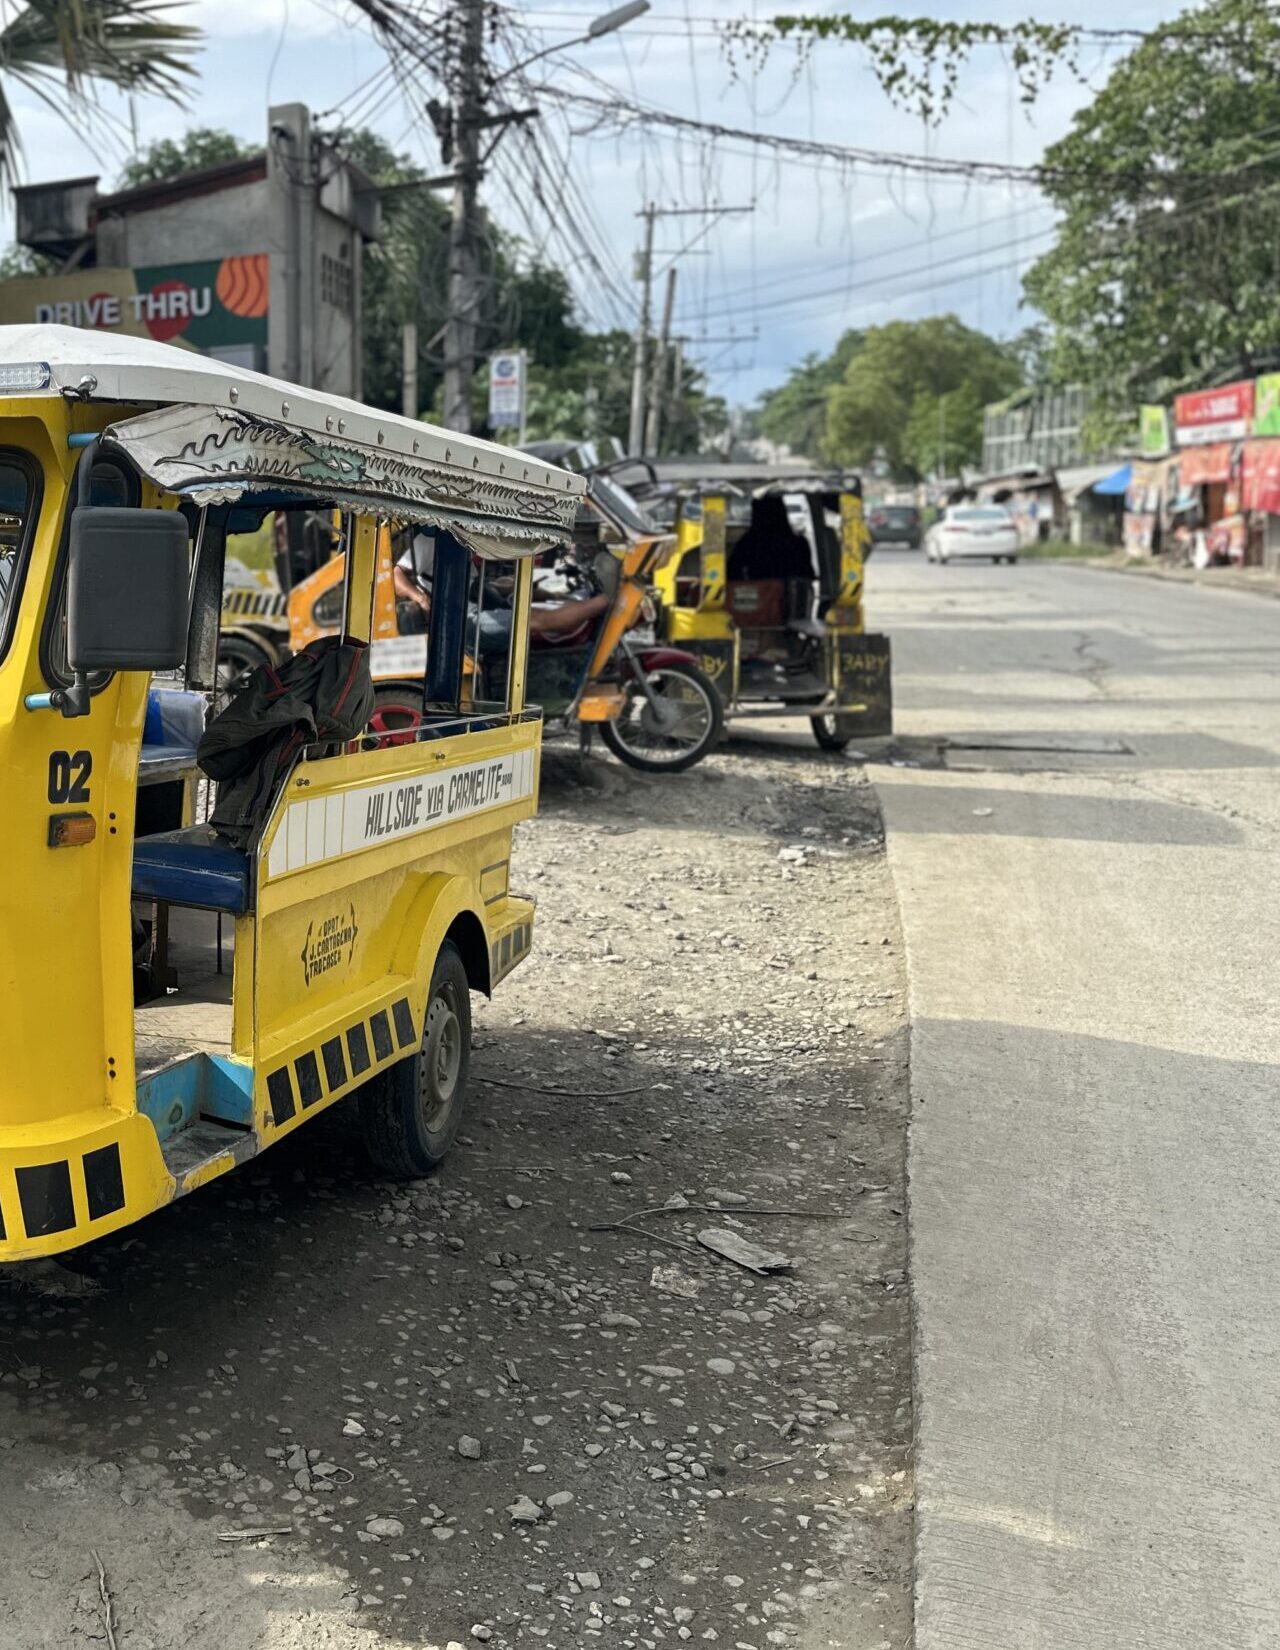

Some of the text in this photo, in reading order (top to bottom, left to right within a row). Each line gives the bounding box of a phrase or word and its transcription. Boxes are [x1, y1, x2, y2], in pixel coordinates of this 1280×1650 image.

[35, 287, 212, 326] DRIVE THRU
[47, 750, 93, 804] 02
[365, 784, 423, 839] HILLSIDE
[426, 784, 444, 815] VIA
[447, 763, 503, 814] CARMELITE
